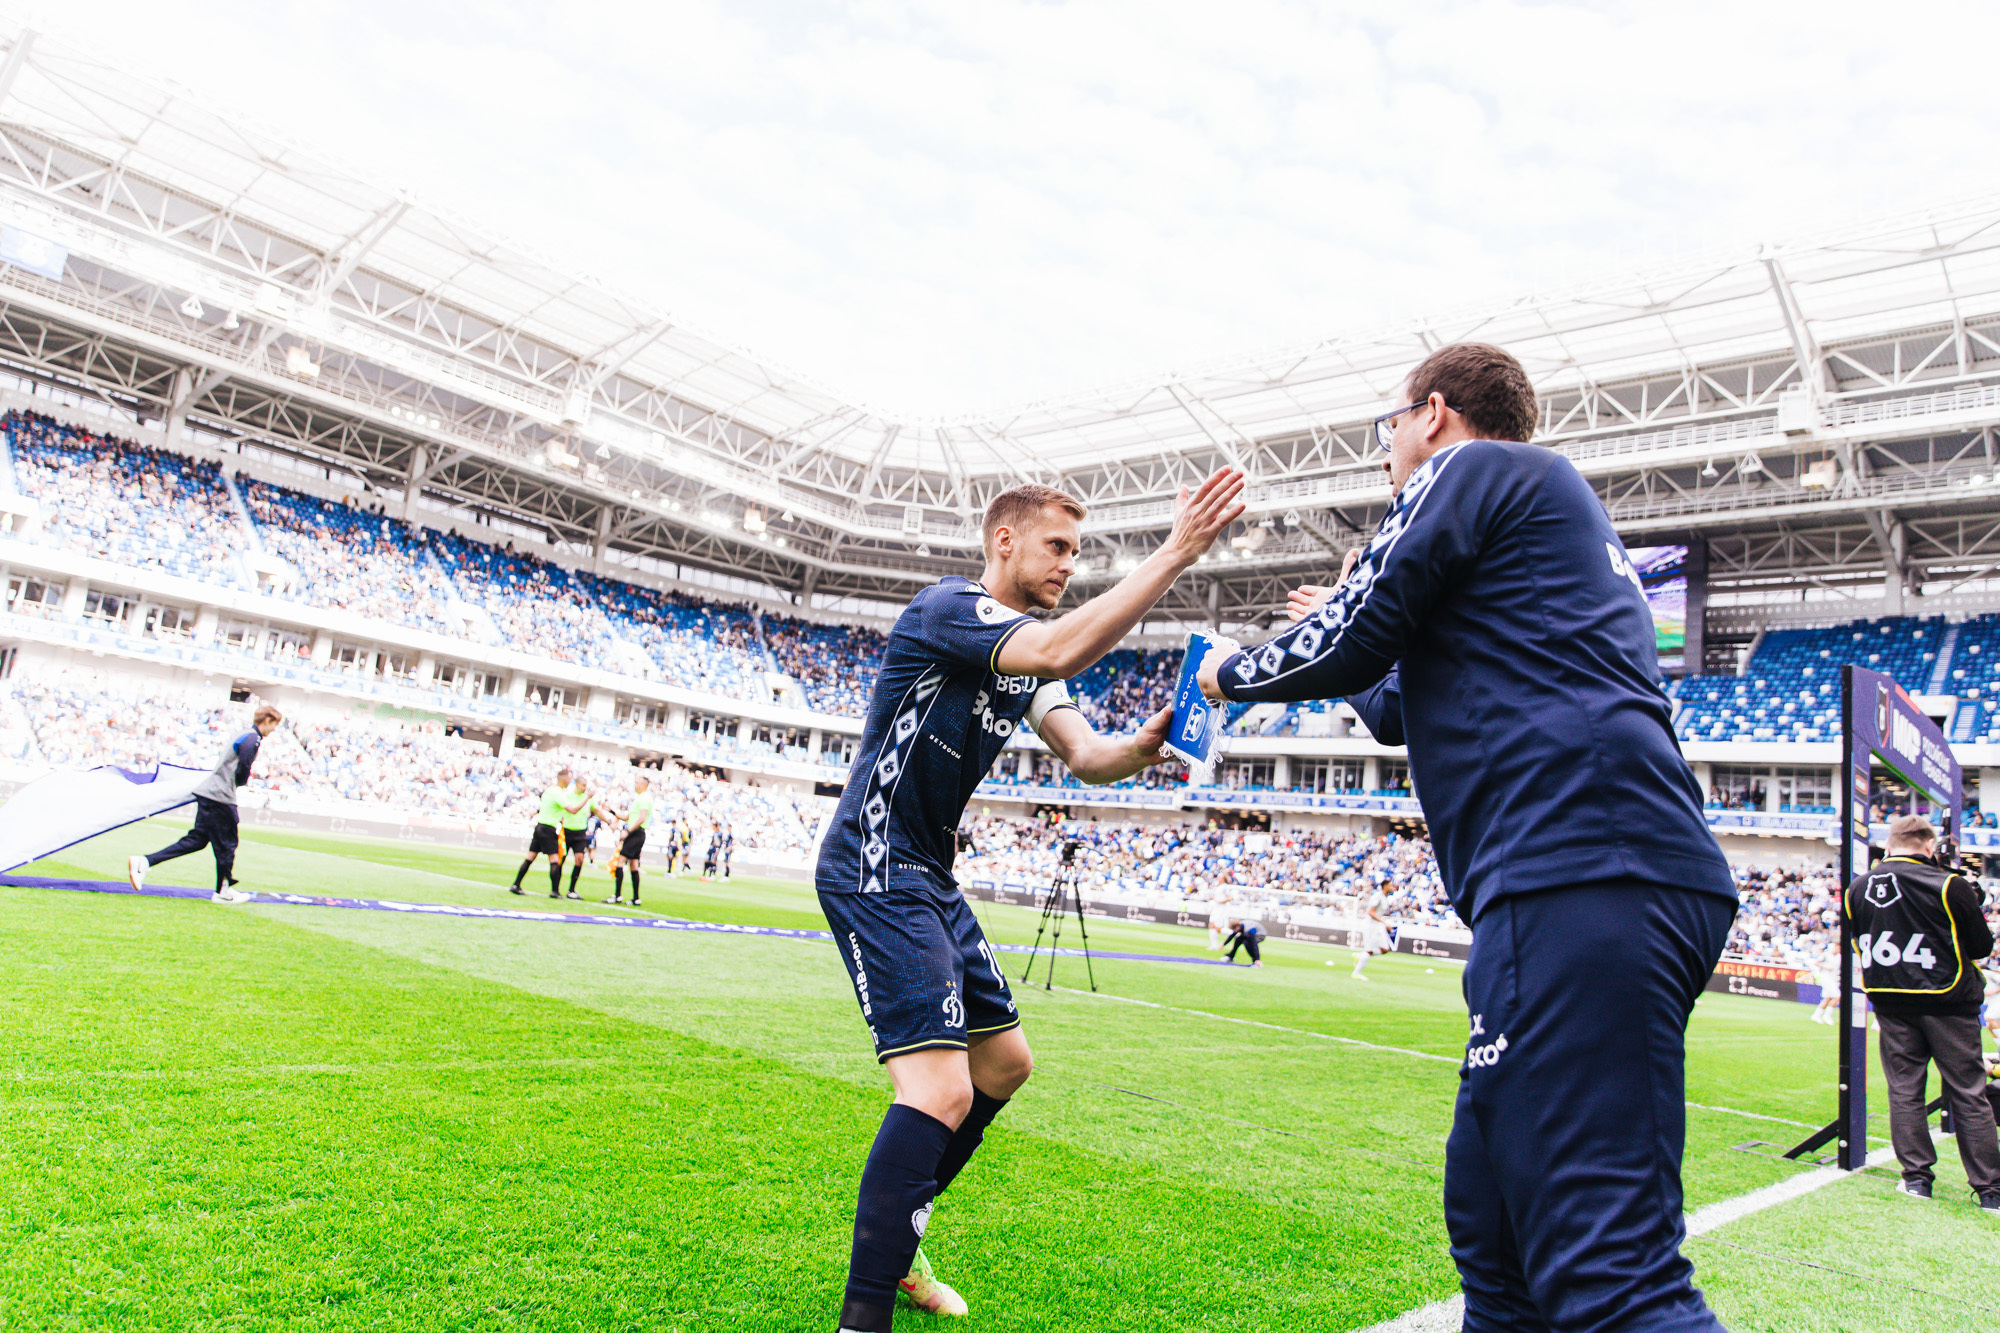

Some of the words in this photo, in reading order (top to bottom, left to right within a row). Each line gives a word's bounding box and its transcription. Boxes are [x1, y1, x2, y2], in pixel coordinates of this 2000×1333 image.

[929, 734, 962, 760] BETBOOM
[898, 863, 929, 873] BETBOOM
[977, 938, 1004, 990] 7
